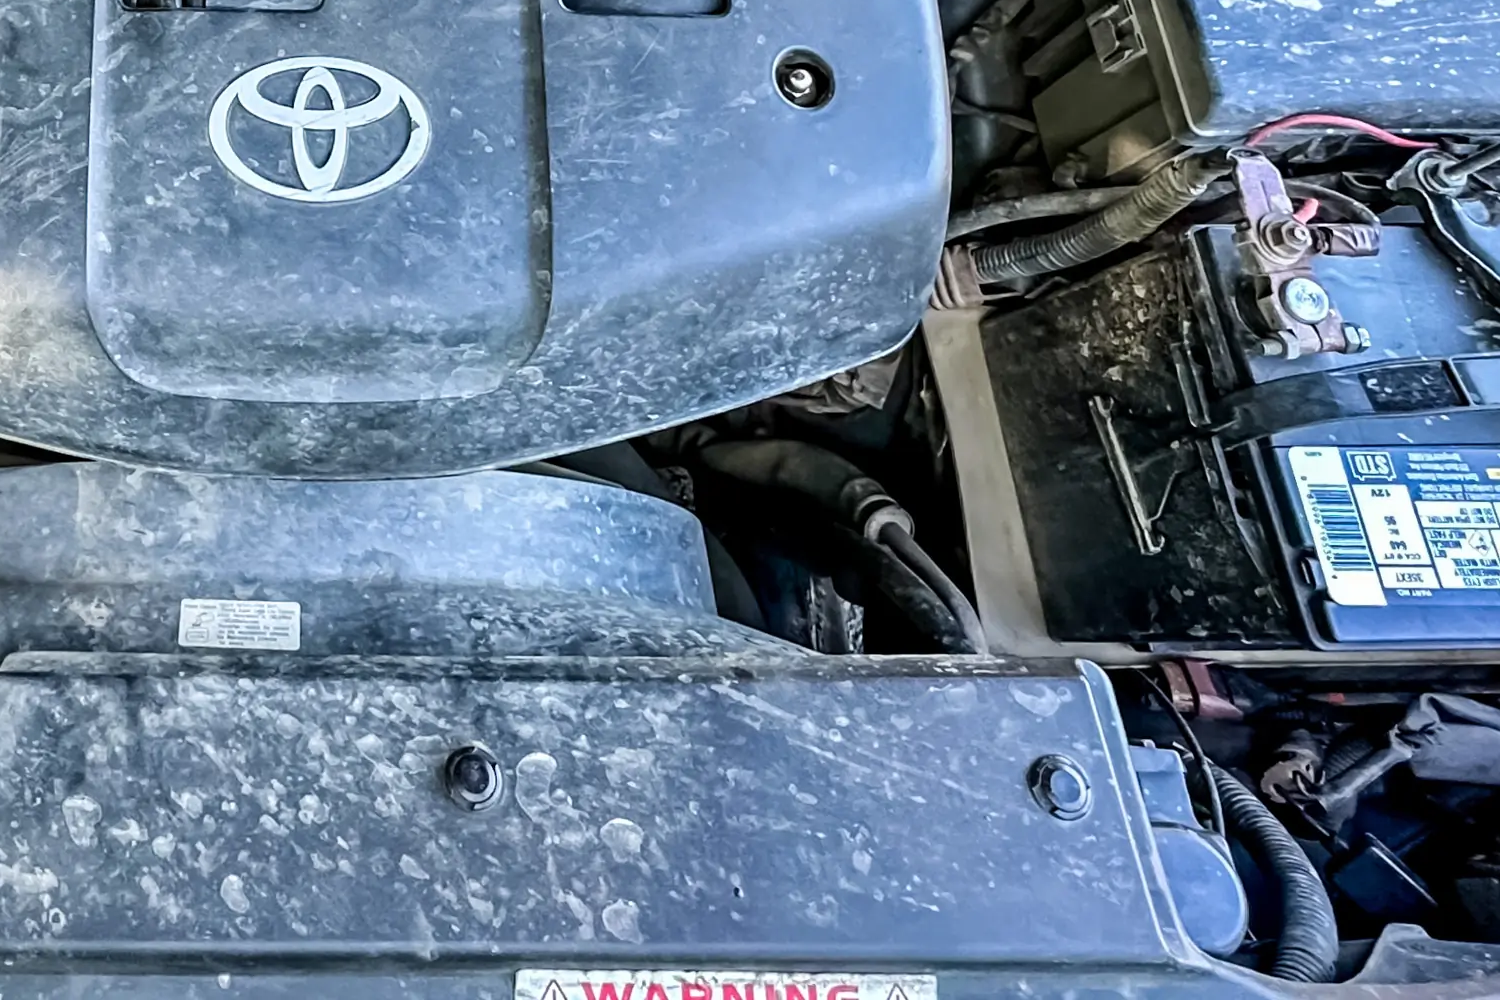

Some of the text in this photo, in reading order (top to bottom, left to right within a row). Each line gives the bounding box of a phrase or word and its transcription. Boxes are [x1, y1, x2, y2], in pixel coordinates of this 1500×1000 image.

[1354, 454, 1389, 475] STD
[1370, 488, 1391, 498] 12V
[1462, 577, 1482, 587] EYES
